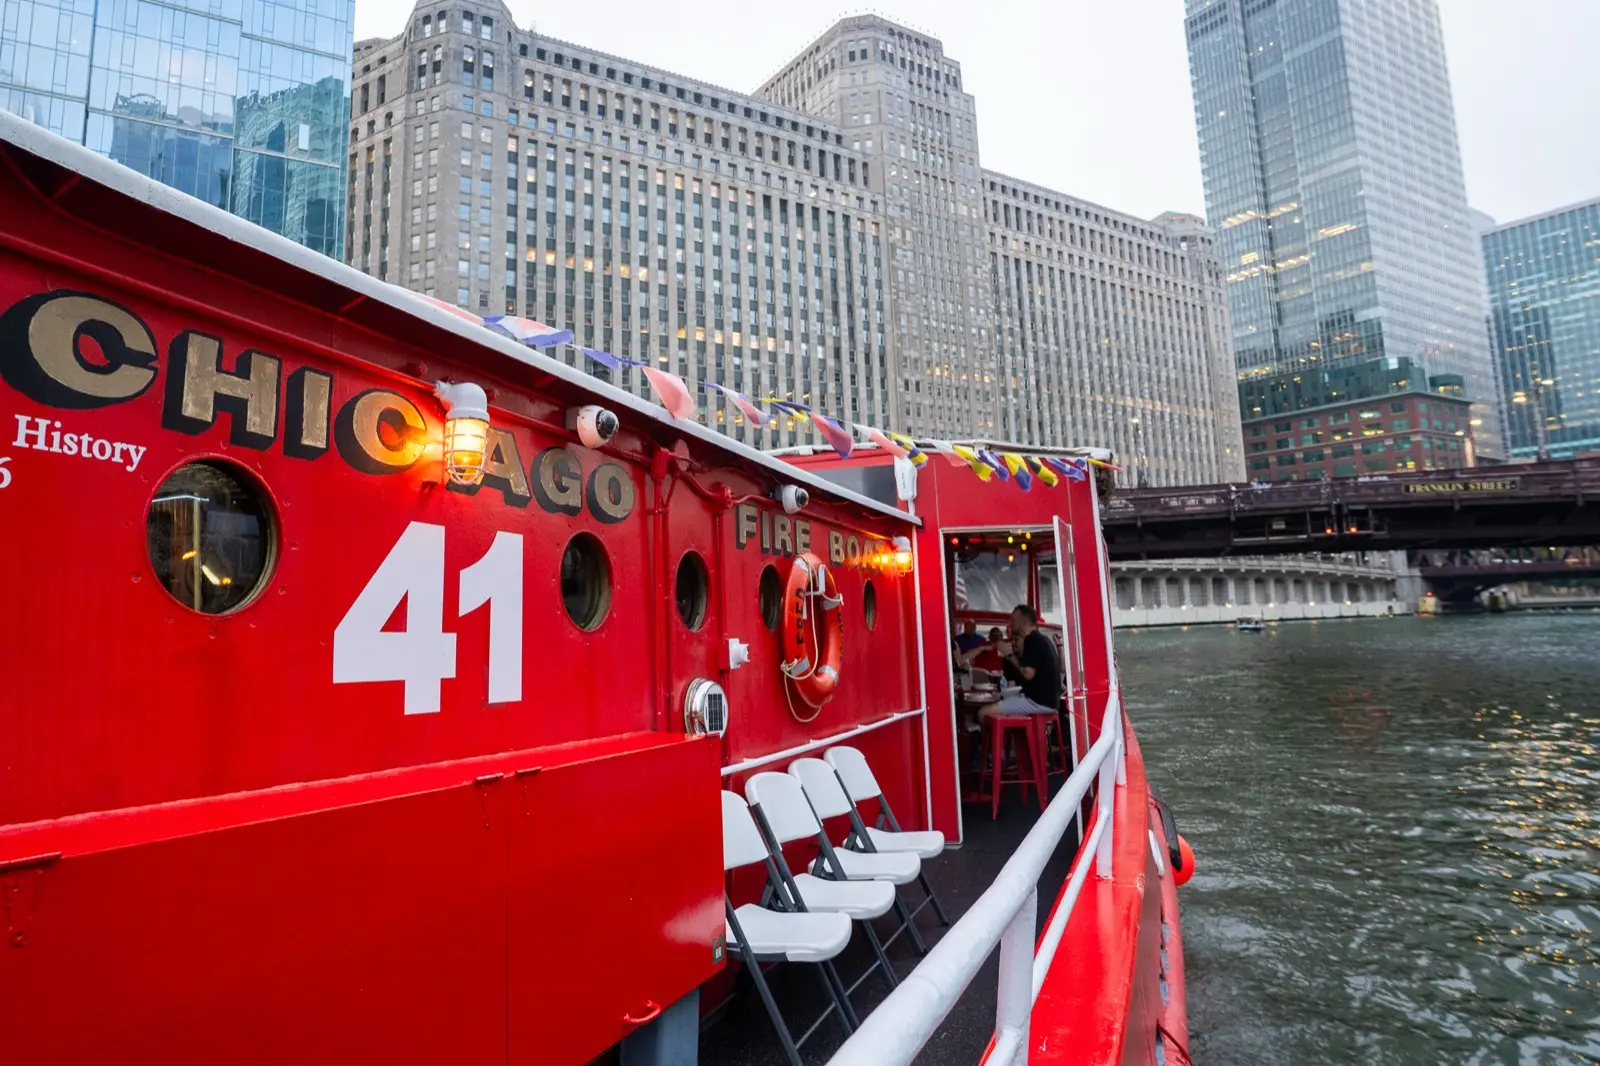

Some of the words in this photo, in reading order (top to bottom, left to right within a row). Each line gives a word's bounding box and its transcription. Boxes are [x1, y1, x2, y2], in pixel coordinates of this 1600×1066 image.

[0, 289, 635, 524] CHICAGO
[736, 503, 811, 558] FIRE
[12, 414, 147, 472] History
[1409, 482, 1464, 493] FRANKLIN
[333, 521, 523, 715] 41
